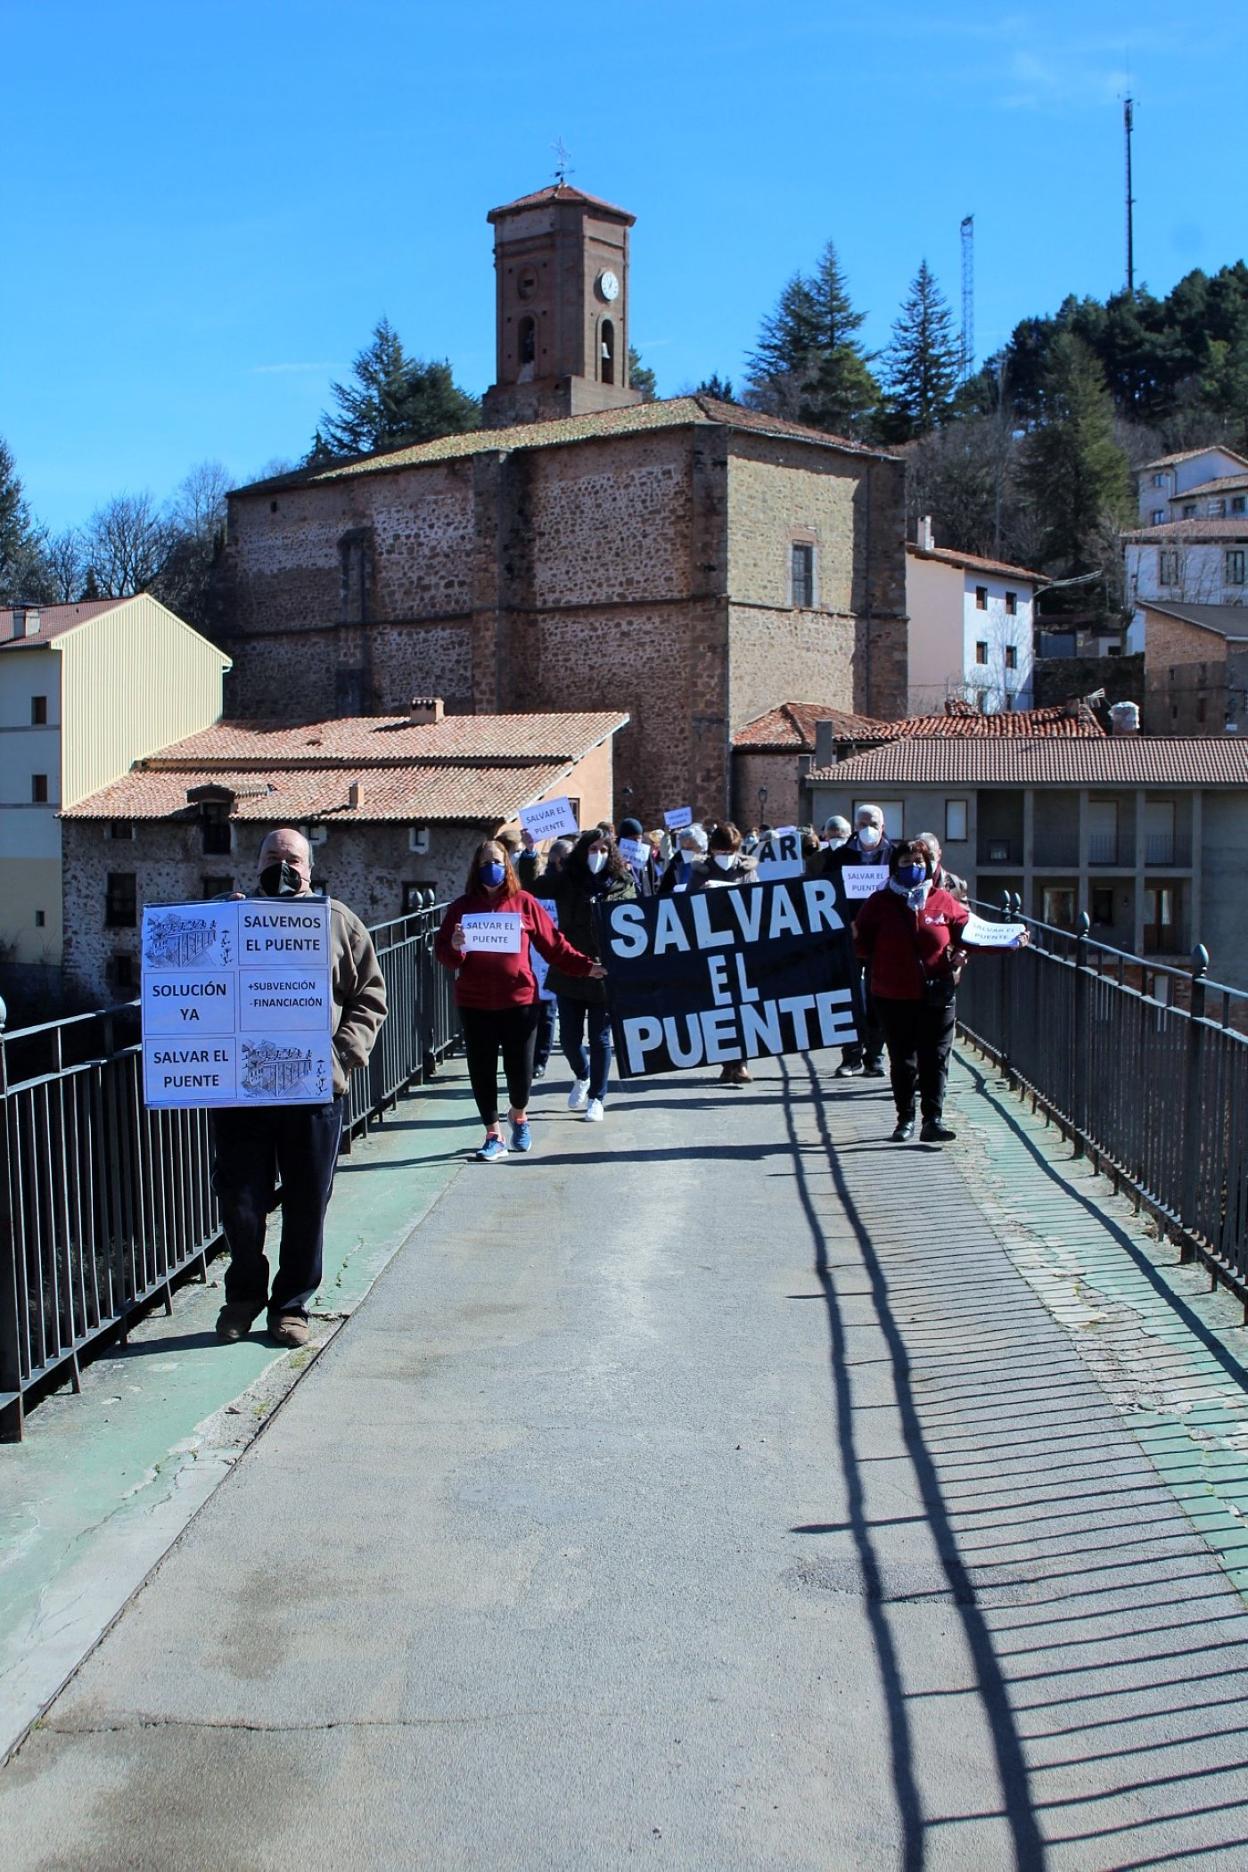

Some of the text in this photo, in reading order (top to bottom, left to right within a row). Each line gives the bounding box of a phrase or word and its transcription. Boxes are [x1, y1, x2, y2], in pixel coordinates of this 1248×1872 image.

[526, 806, 566, 824] SALVAR EL
[534, 820, 565, 834] PUENTE
[244, 915, 321, 929] SALVEMOS
[466, 921, 515, 931] SALVAR EL
[610, 879, 845, 959] SALVAR
[246, 939, 320, 951] EL PUENTE
[472, 935, 509, 944] PUENTE
[707, 952, 760, 1006] EL
[152, 981, 227, 997] SOLUCIÓN
[180, 1008, 200, 1021] YA
[622, 988, 859, 1074] PUENTE
[153, 1049, 229, 1064] SALVAR EL
[164, 1074, 220, 1088] PUENTE
